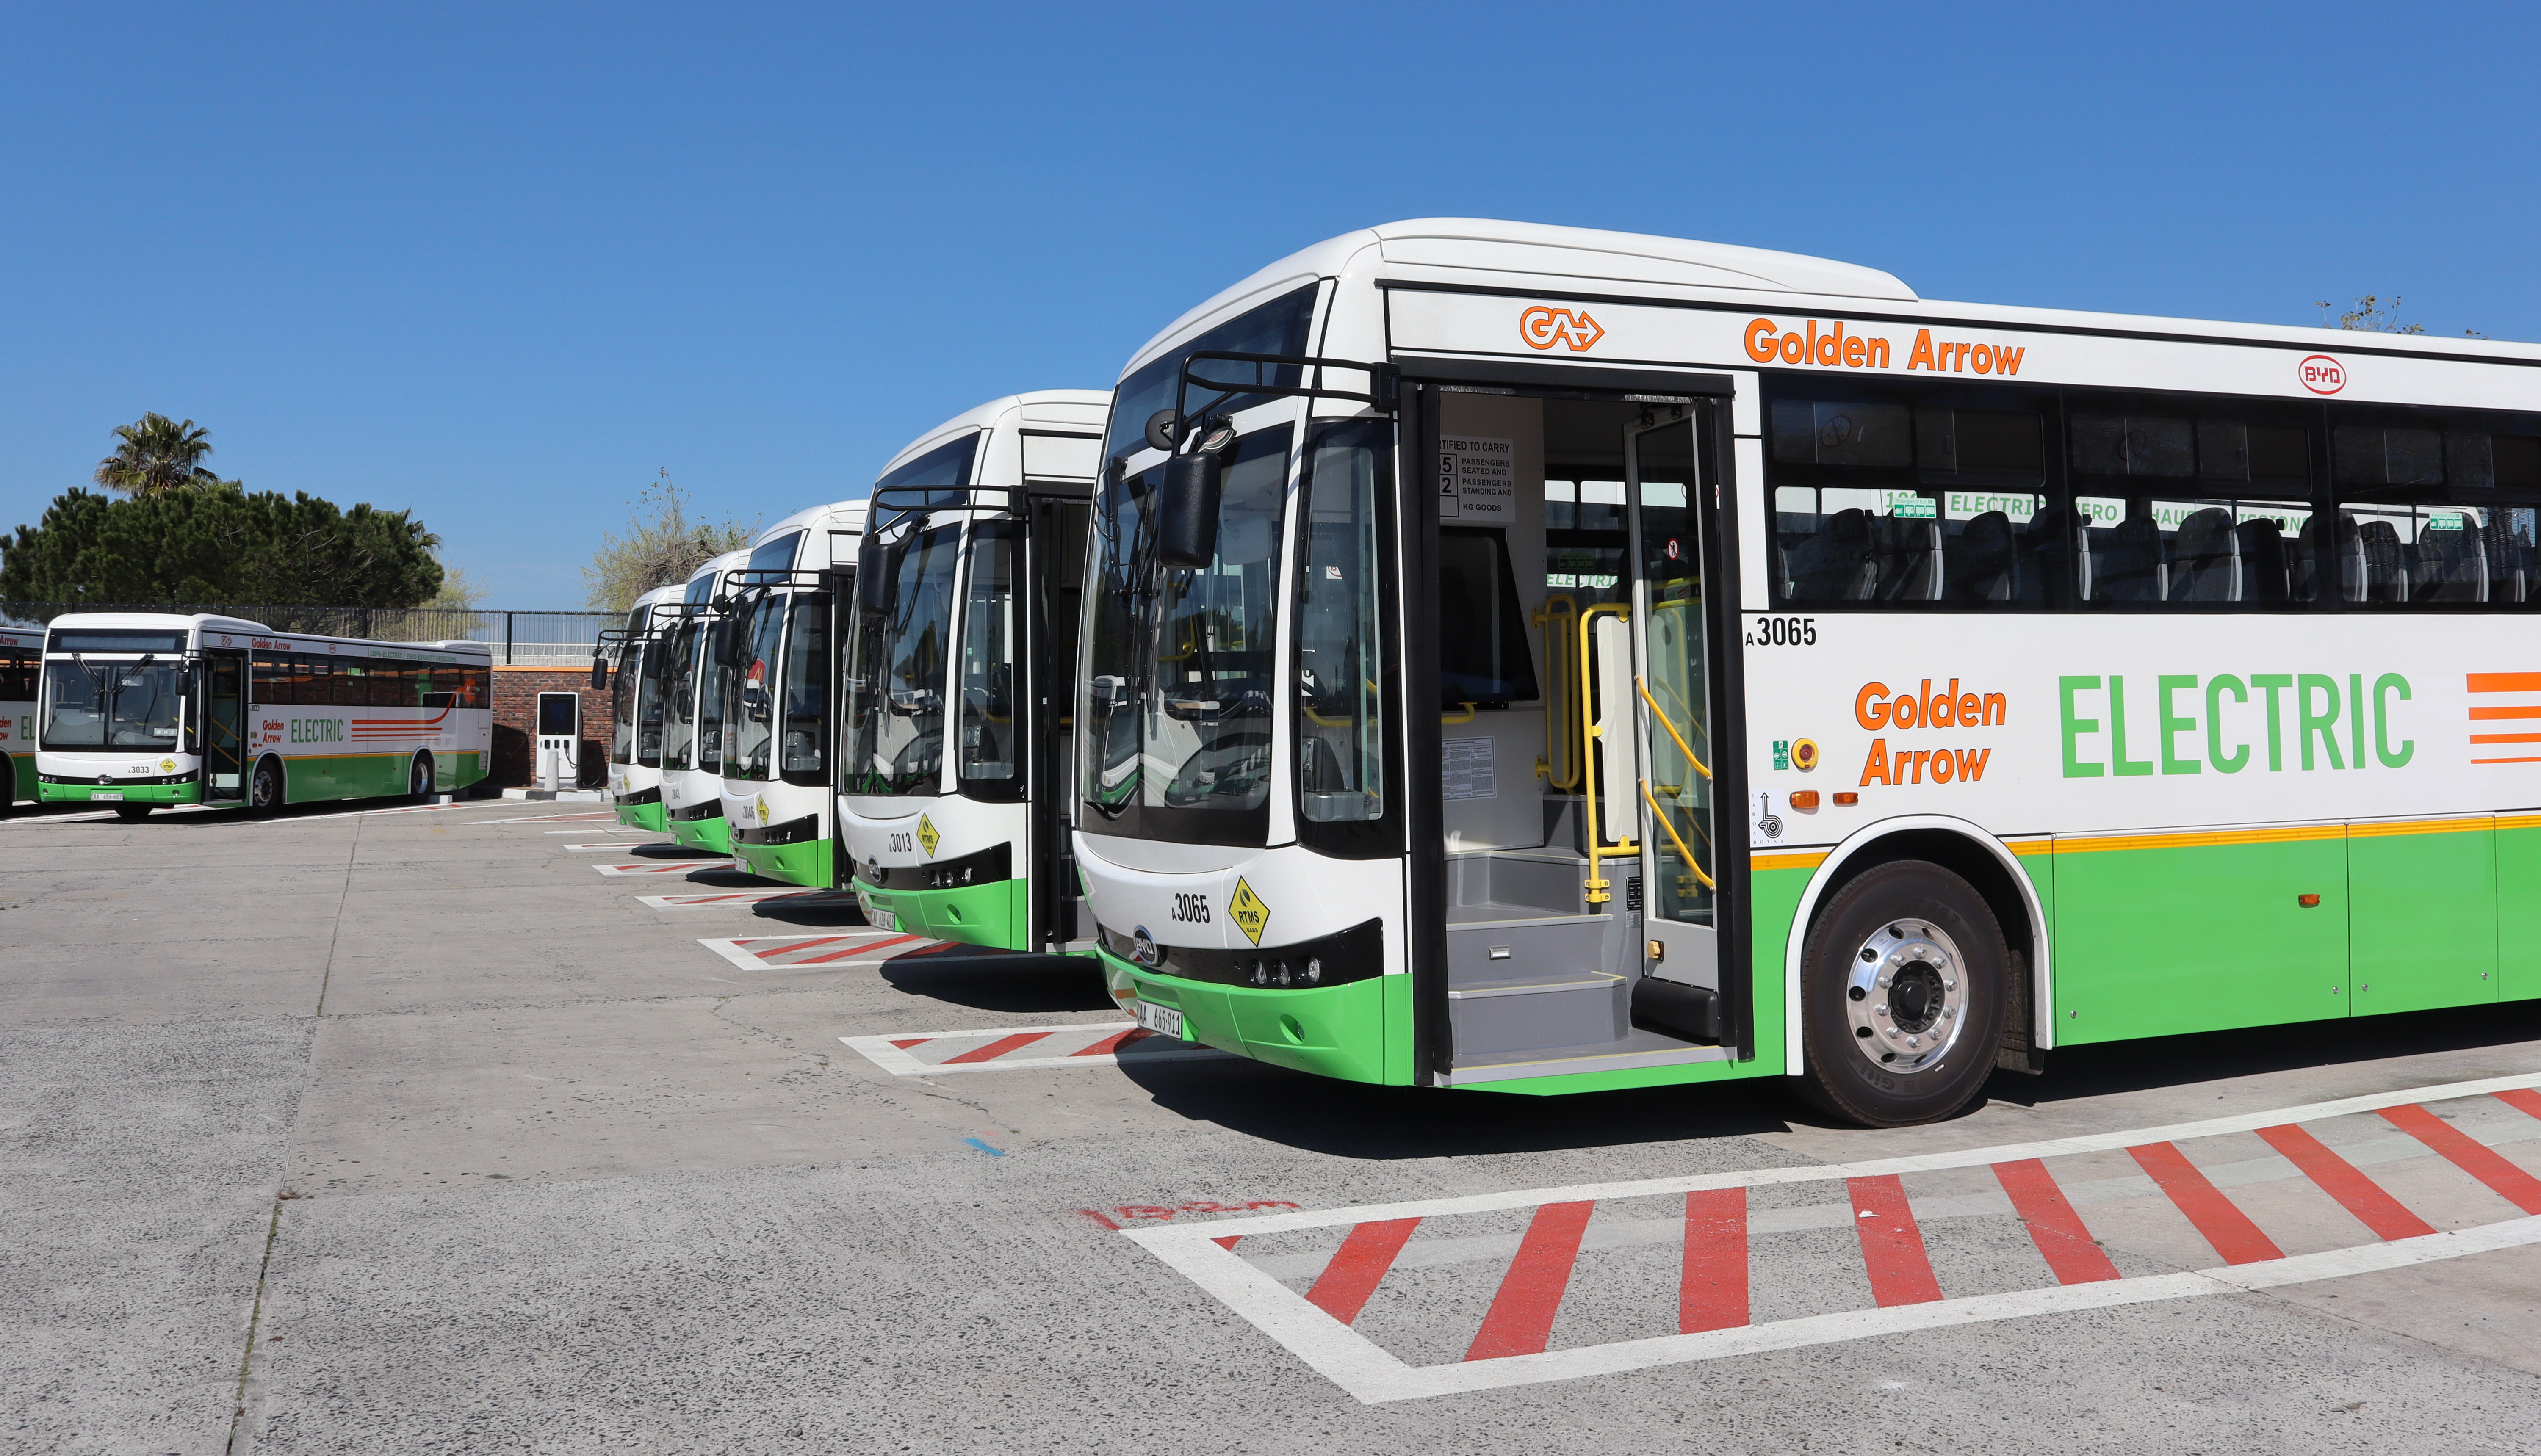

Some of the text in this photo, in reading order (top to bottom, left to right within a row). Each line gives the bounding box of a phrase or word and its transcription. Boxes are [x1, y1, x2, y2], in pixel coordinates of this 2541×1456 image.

[1744, 318, 2025, 376] Golden Arrow
[2305, 365, 2341, 384] BYD
[1469, 441, 1480, 452] TO
[1482, 442, 1510, 453] CARRY
[1440, 456, 1452, 473] 5
[1461, 458, 1510, 467] PASSENGERS
[1462, 467, 1490, 475] SEATED
[1462, 478, 1511, 487] PASSENGERS
[1462, 487, 1496, 495] STANDING
[1951, 495, 2046, 515] ELECTRI
[1745, 617, 1817, 646] A3065
[0, 636, 19, 646] Arrow
[252, 638, 291, 651] Golden Arrow
[1855, 678, 2007, 731] Golden
[263, 719, 284, 731] Golden
[291, 719, 344, 743] ELECTRIC
[2059, 672, 2414, 779] ELECTRIC
[263, 732, 281, 743] Arrow
[1858, 738, 1991, 787] Arrow
[922, 834, 934, 844] RTMS
[1172, 893, 1210, 924] A3065
[1238, 910, 1260, 923] RTMS
[1137, 1002, 1147, 1025] CAA
[1860, 1064, 1896, 1091] Giti
